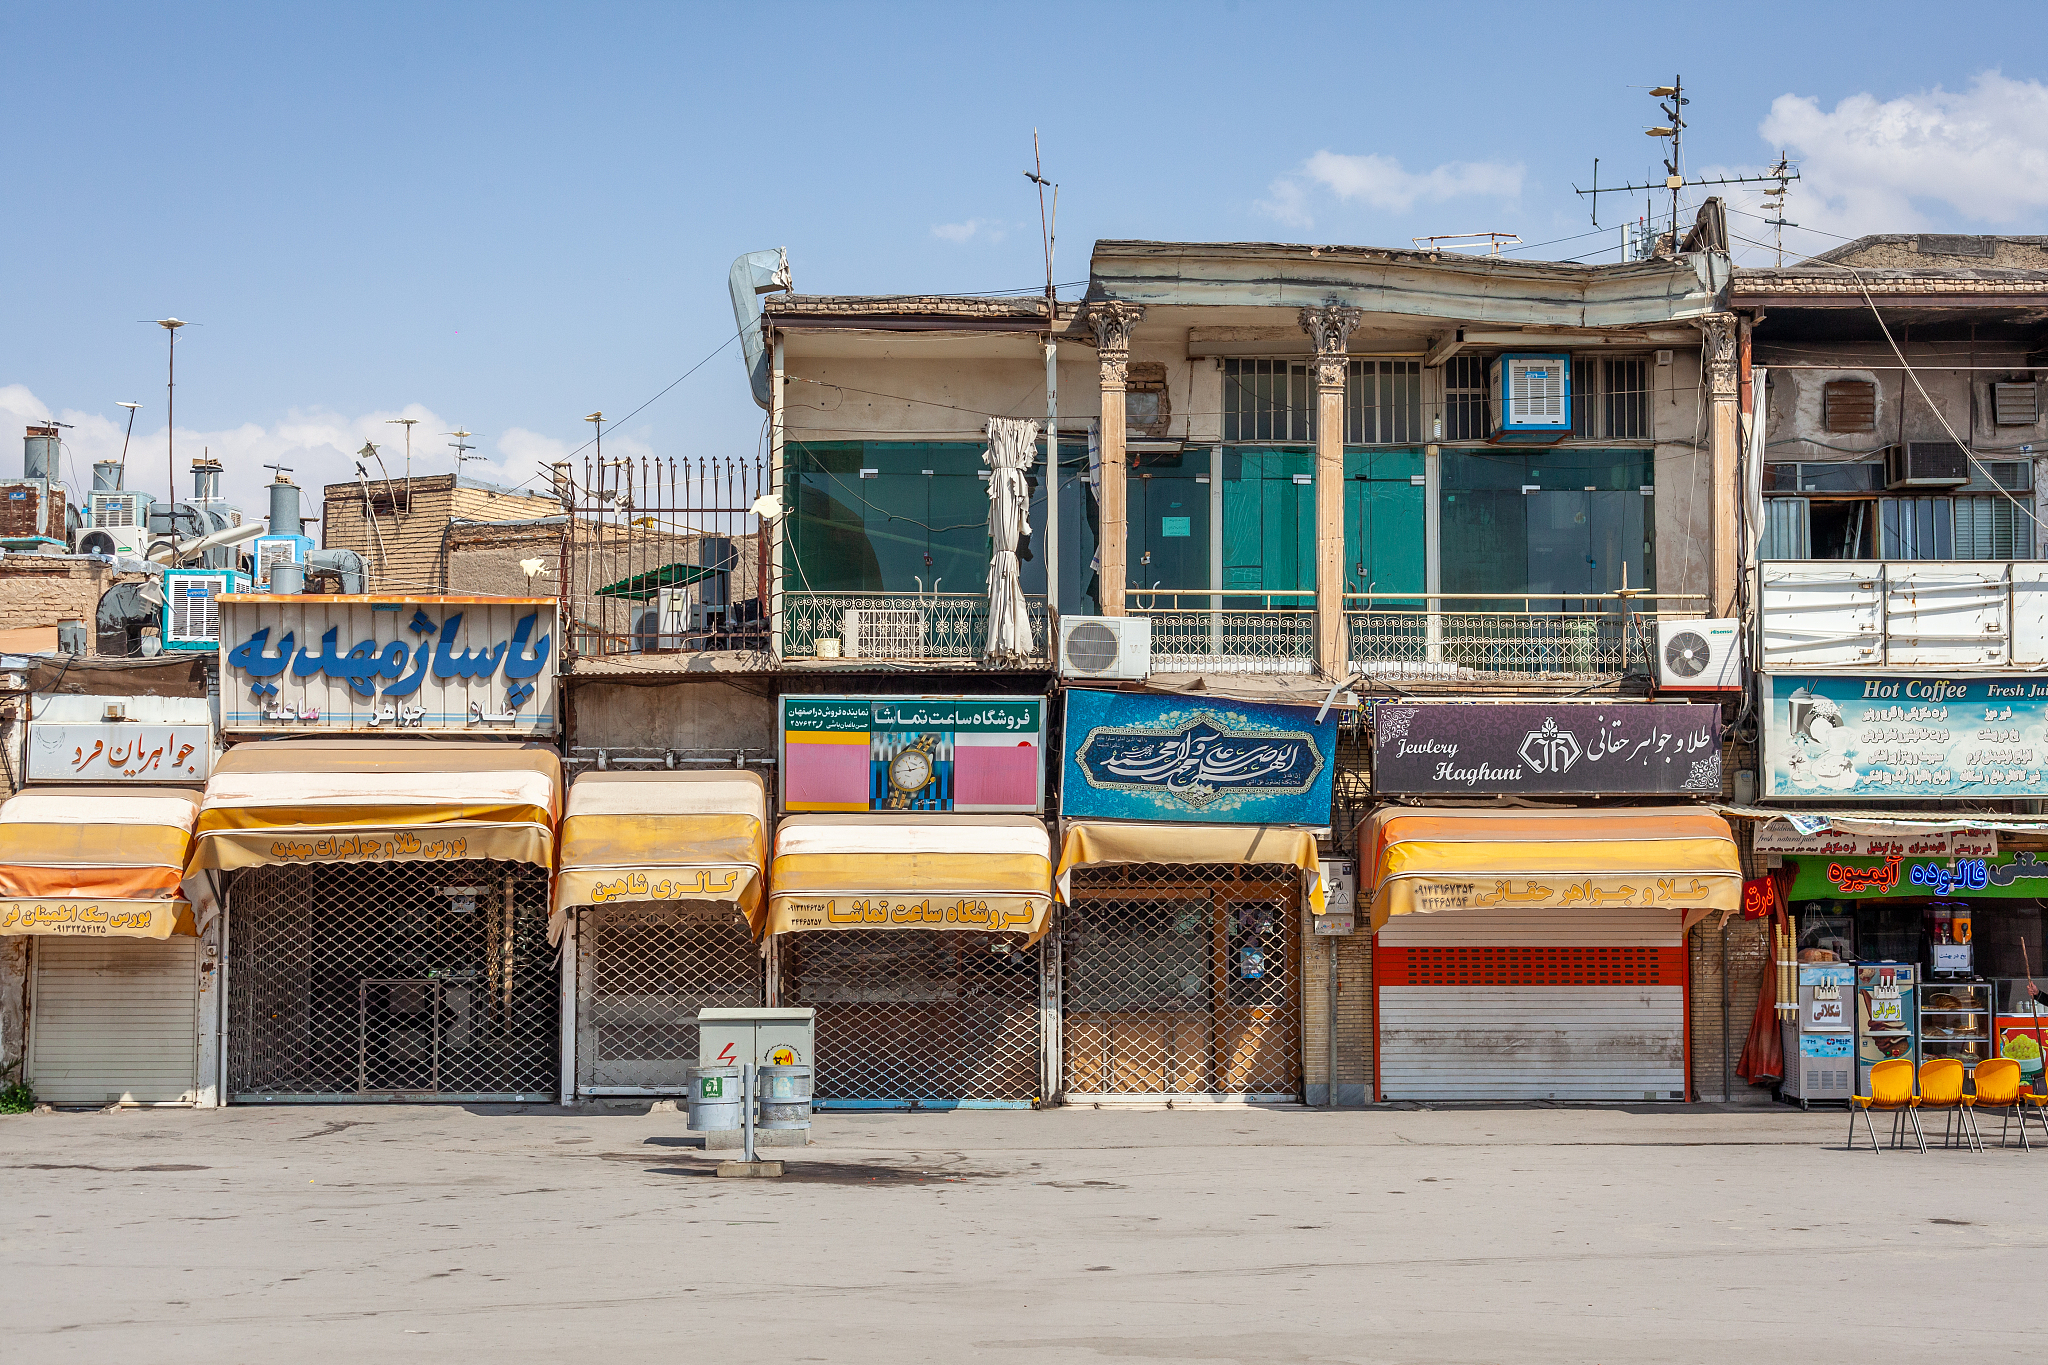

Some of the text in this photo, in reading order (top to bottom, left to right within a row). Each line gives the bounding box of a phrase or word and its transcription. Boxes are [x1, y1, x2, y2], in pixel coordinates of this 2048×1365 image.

[228, 610, 550, 707] پاساژ مهدیه
[1862, 680, 1900, 699] Hot
[1906, 680, 1967, 702] Coffee
[1987, 684, 2025, 697] Fresh
[264, 697, 516, 726] طلا جواهر ساعت
[788, 708, 815, 717] اصفهان
[822, 706, 842, 718] فروش
[842, 708, 869, 718] نماینده
[874, 708, 1031, 730] فروشگاه ساعت تماشا
[1396, 739, 1459, 758] Jewlery
[1587, 715, 1711, 766] طلا و جواهر حقانی
[71, 732, 196, 777] جواهریان فرد
[1432, 762, 1522, 786] Haghani
[270, 832, 467, 862] بورس طلا و جواهرات مهدیه
[1756, 834, 1773, 848] fresh
[1777, 834, 1802, 842] natural
[1826, 855, 1904, 894] آبمیوه
[1909, 858, 1988, 896] فالوده
[591, 871, 738, 903] گالری شاهین
[1474, 878, 1709, 908] طلا و جواهر حقانی
[1746, 880, 1774, 917] ذرت
[22, 905, 78, 926] اطمینان
[78, 906, 108, 923] سکه
[110, 910, 152, 928] بورس
[827, 900, 1034, 930] فروشگاه ساعت تماشا
[1813, 1004, 1841, 1021] شکلاتی
[1872, 1002, 1900, 1019] زعفرانی
